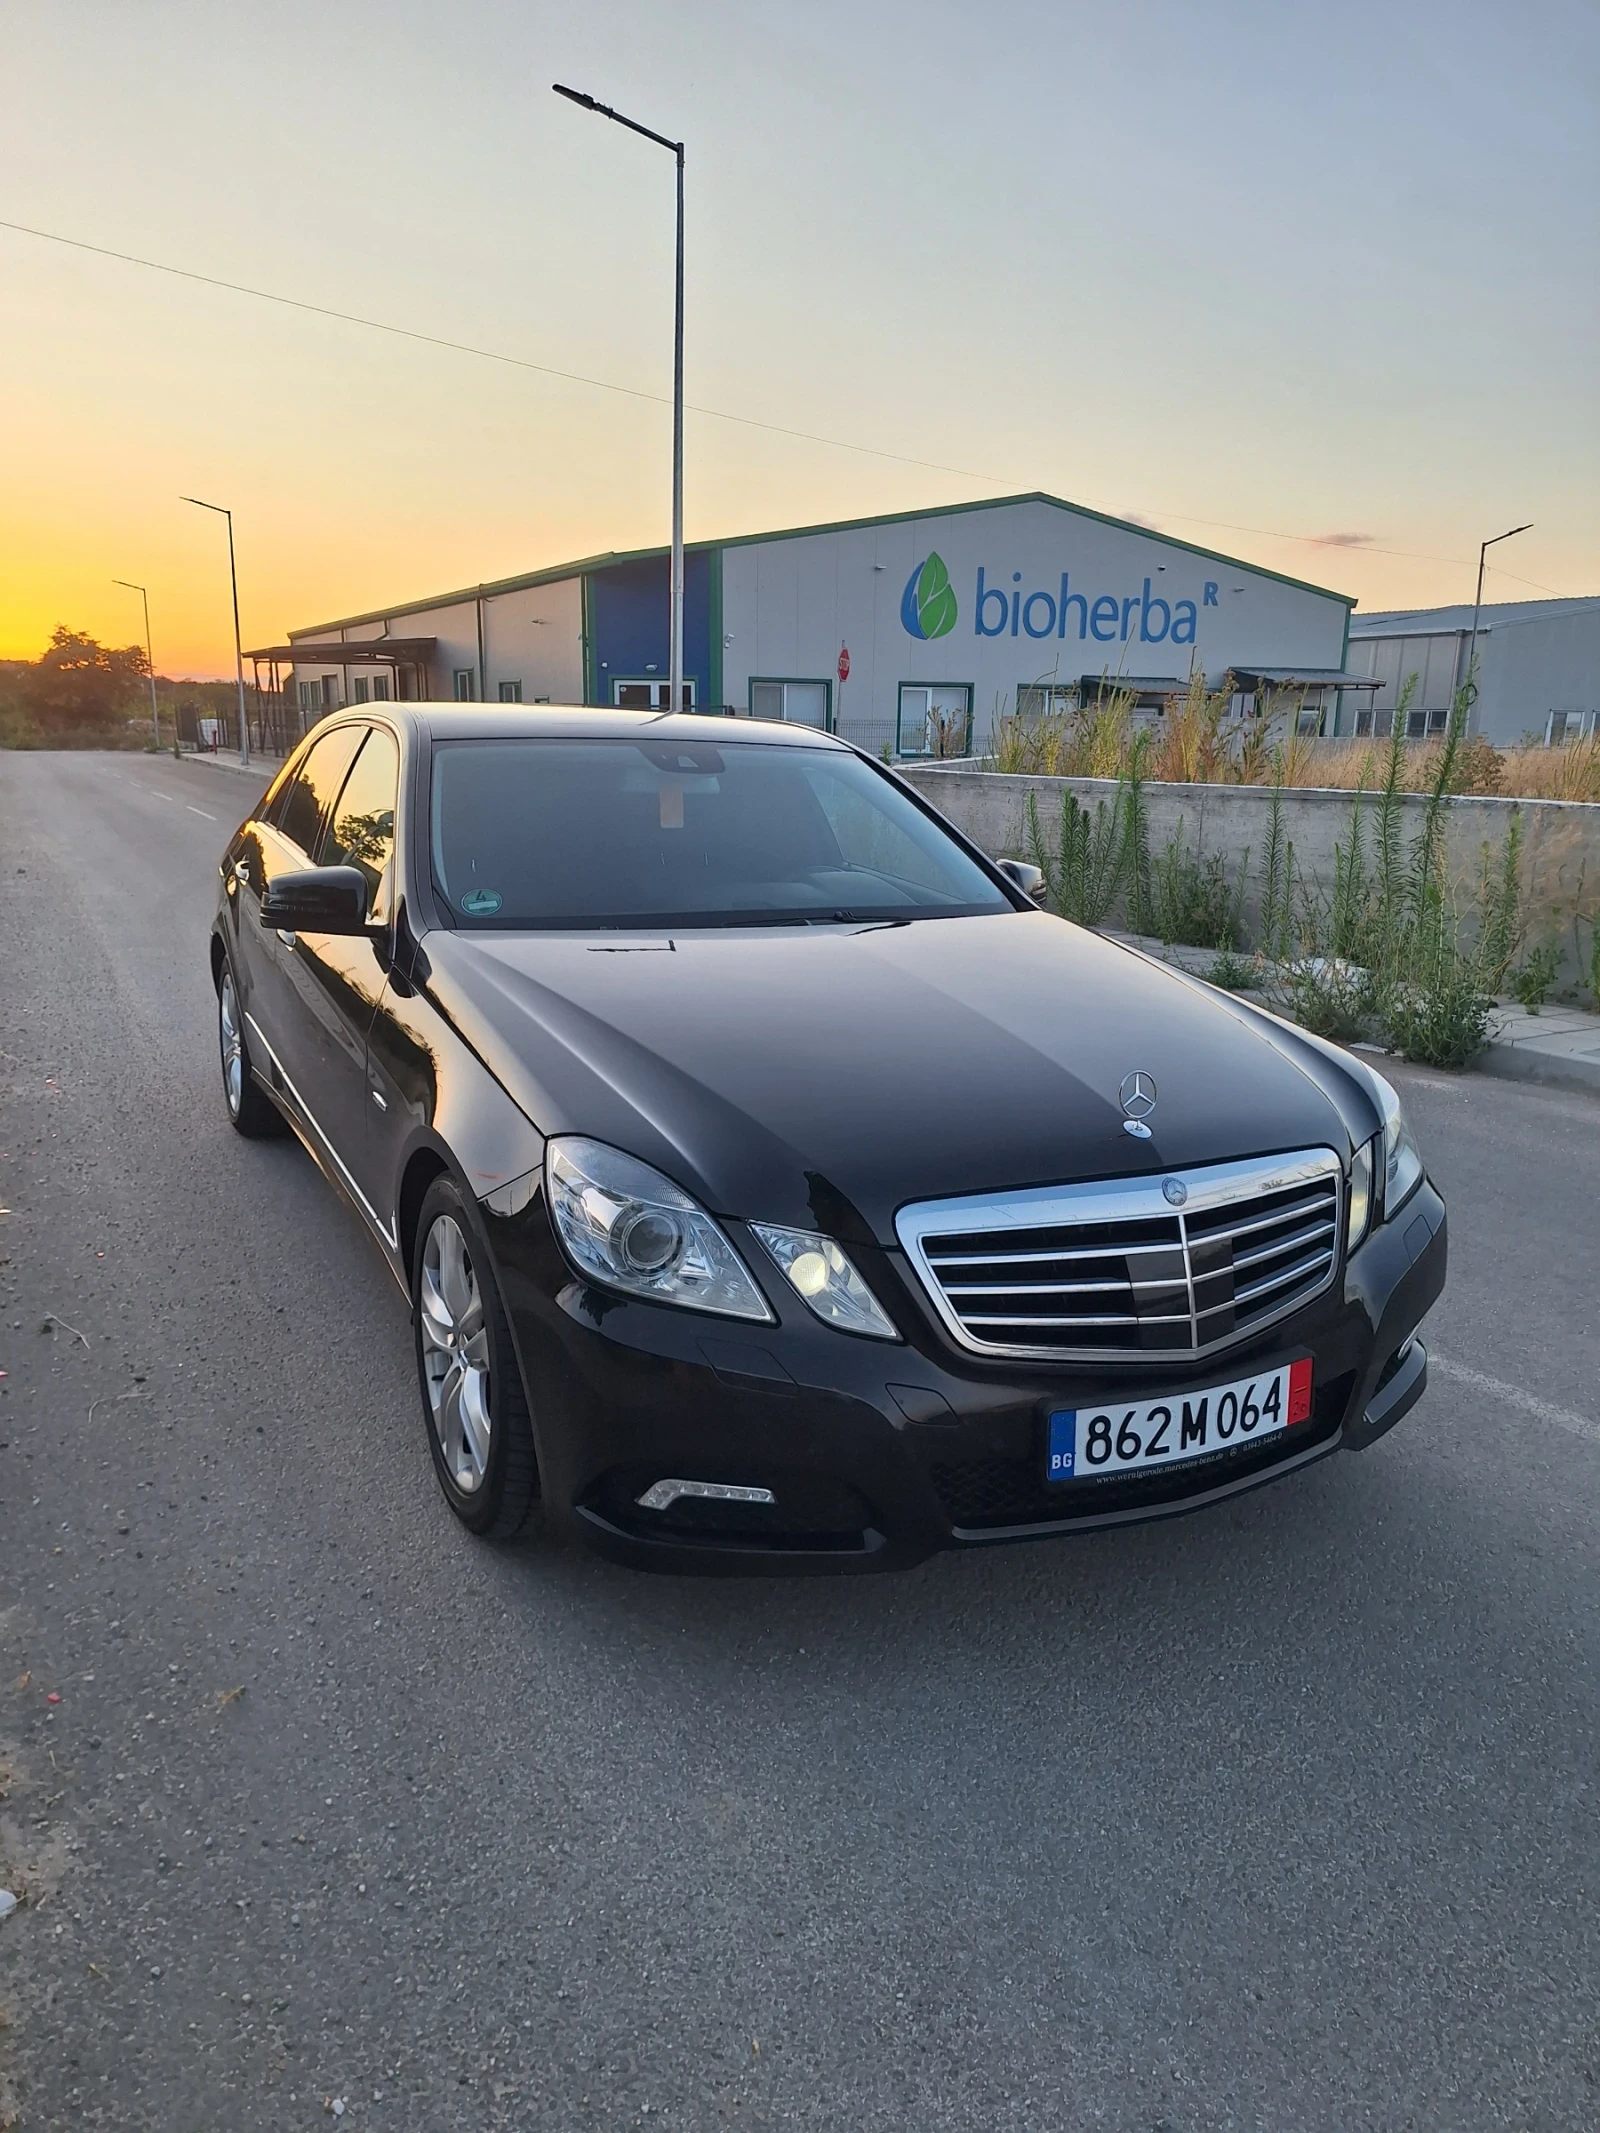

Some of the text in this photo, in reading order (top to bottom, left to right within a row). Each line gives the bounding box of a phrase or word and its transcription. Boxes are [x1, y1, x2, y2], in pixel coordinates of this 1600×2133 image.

[974, 566, 1219, 644] bioherba R
[839, 657, 850, 671] STOP
[475, 889, 488, 902] 4
[1051, 1452, 1073, 1470] BG
[1085, 1406, 1170, 1465] 862
